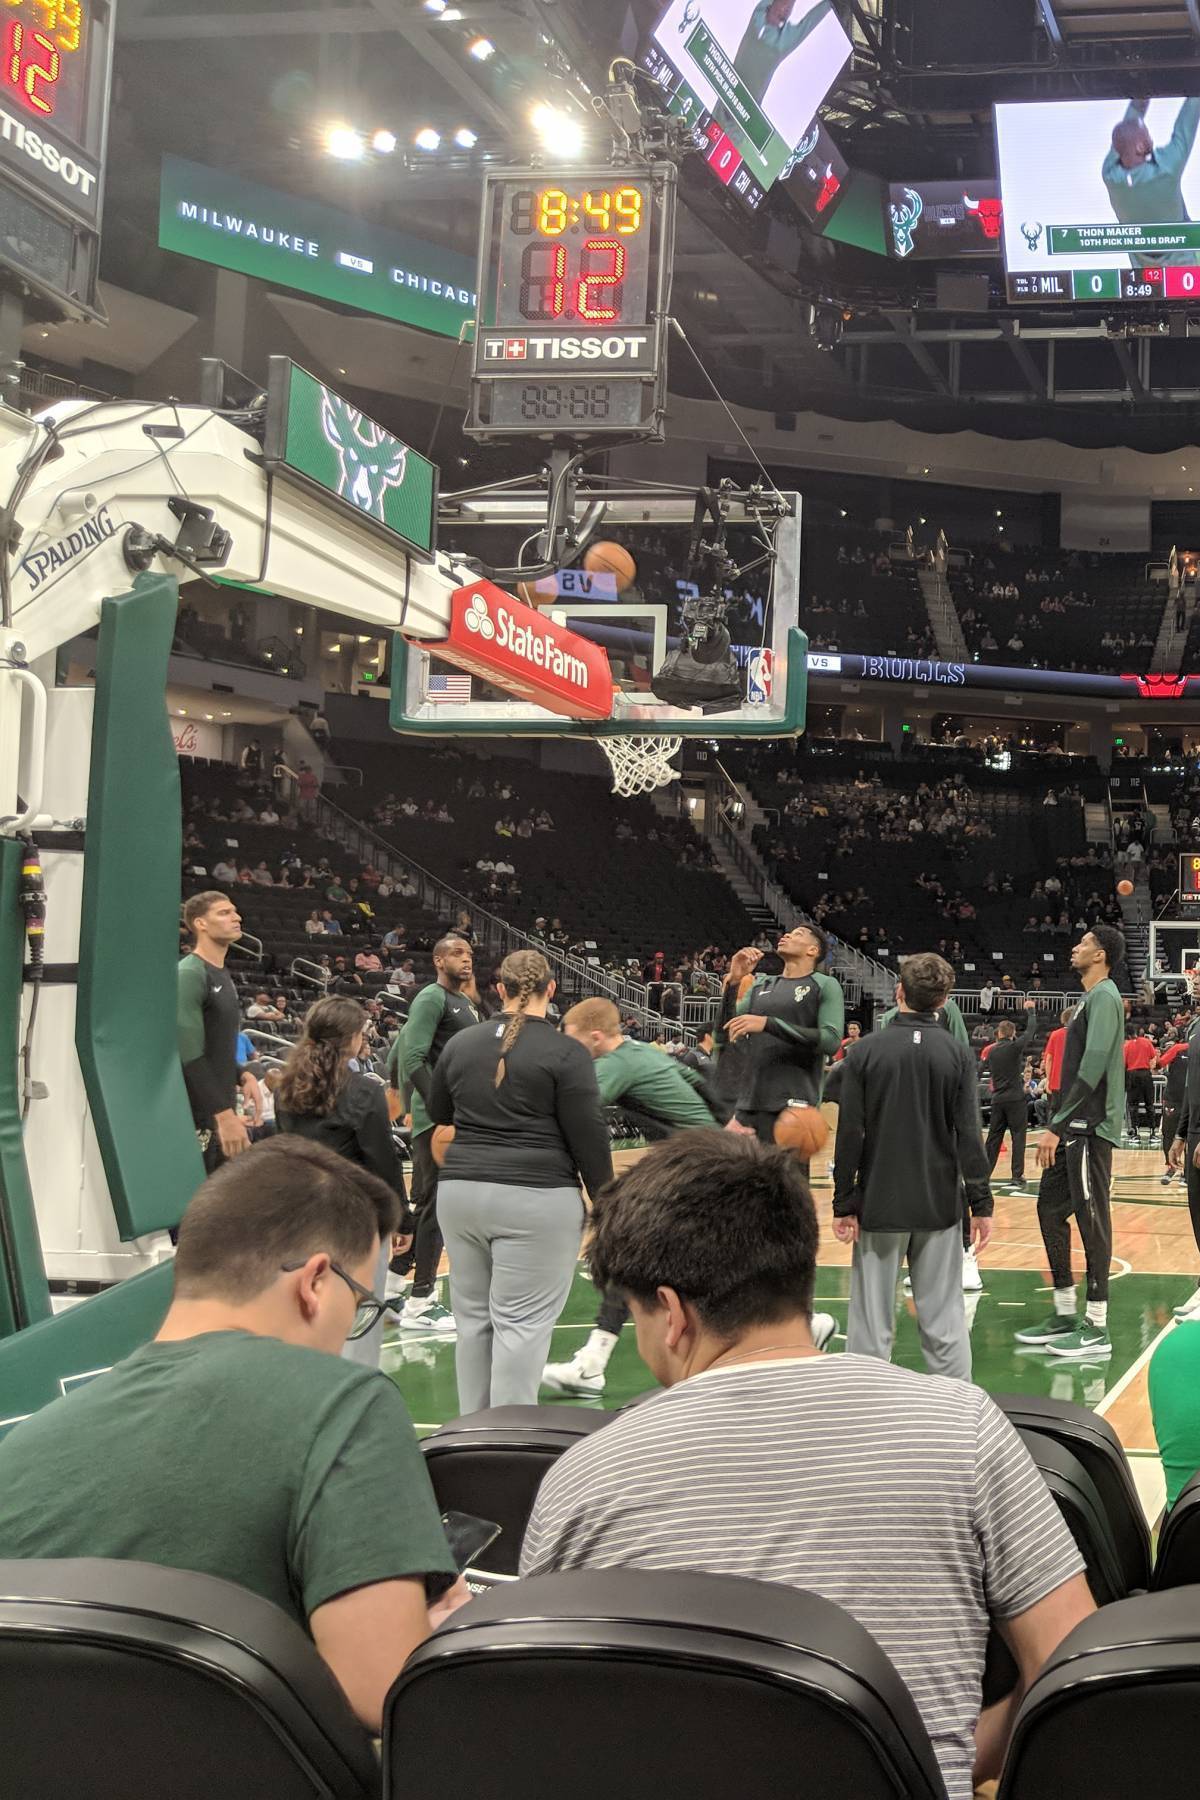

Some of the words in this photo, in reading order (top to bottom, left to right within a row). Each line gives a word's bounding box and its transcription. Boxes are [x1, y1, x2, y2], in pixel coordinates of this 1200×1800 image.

[701, 32, 708, 42] 7
[10, 22, 60, 114] 12
[708, 42, 724, 65] THON
[720, 63, 739, 88] MAKER
[657, 64, 674, 92] MIL
[703, 54, 715, 73] 10TH
[713, 69, 726, 86] PICK
[726, 88, 739, 106] 2016
[735, 102, 751, 122] DRAFT
[0, 108, 96, 196] TISSOT
[719, 150, 732, 169] 0
[735, 170, 751, 194] CHI
[540, 188, 641, 234] 8:49
[181, 201, 319, 257] MILWAUKEE
[1061, 229, 1068, 238] 7
[1077, 228, 1104, 237] THON
[1106, 227, 1141, 236] MAKER
[1081, 238, 1100, 246] 10TH
[1102, 237, 1122, 246] PICK
[1124, 237, 1133, 245] IN
[1134, 236, 1157, 245] 2016
[1158, 236, 1186, 245] DRAFT
[553, 240, 625, 319] 12
[1041, 277, 1063, 293] MIL
[1091, 275, 1103, 293] 0
[1129, 271, 1136, 281] 1
[1148, 271, 1160, 280] 12
[1182, 272, 1194, 290] 0
[1126, 284, 1151, 296] 8:49
[530, 337, 647, 359] TISSOT
[21, 505, 116, 592] SPALDING
[811, 658, 828, 667] VS
[861, 655, 965, 685] BULLS
